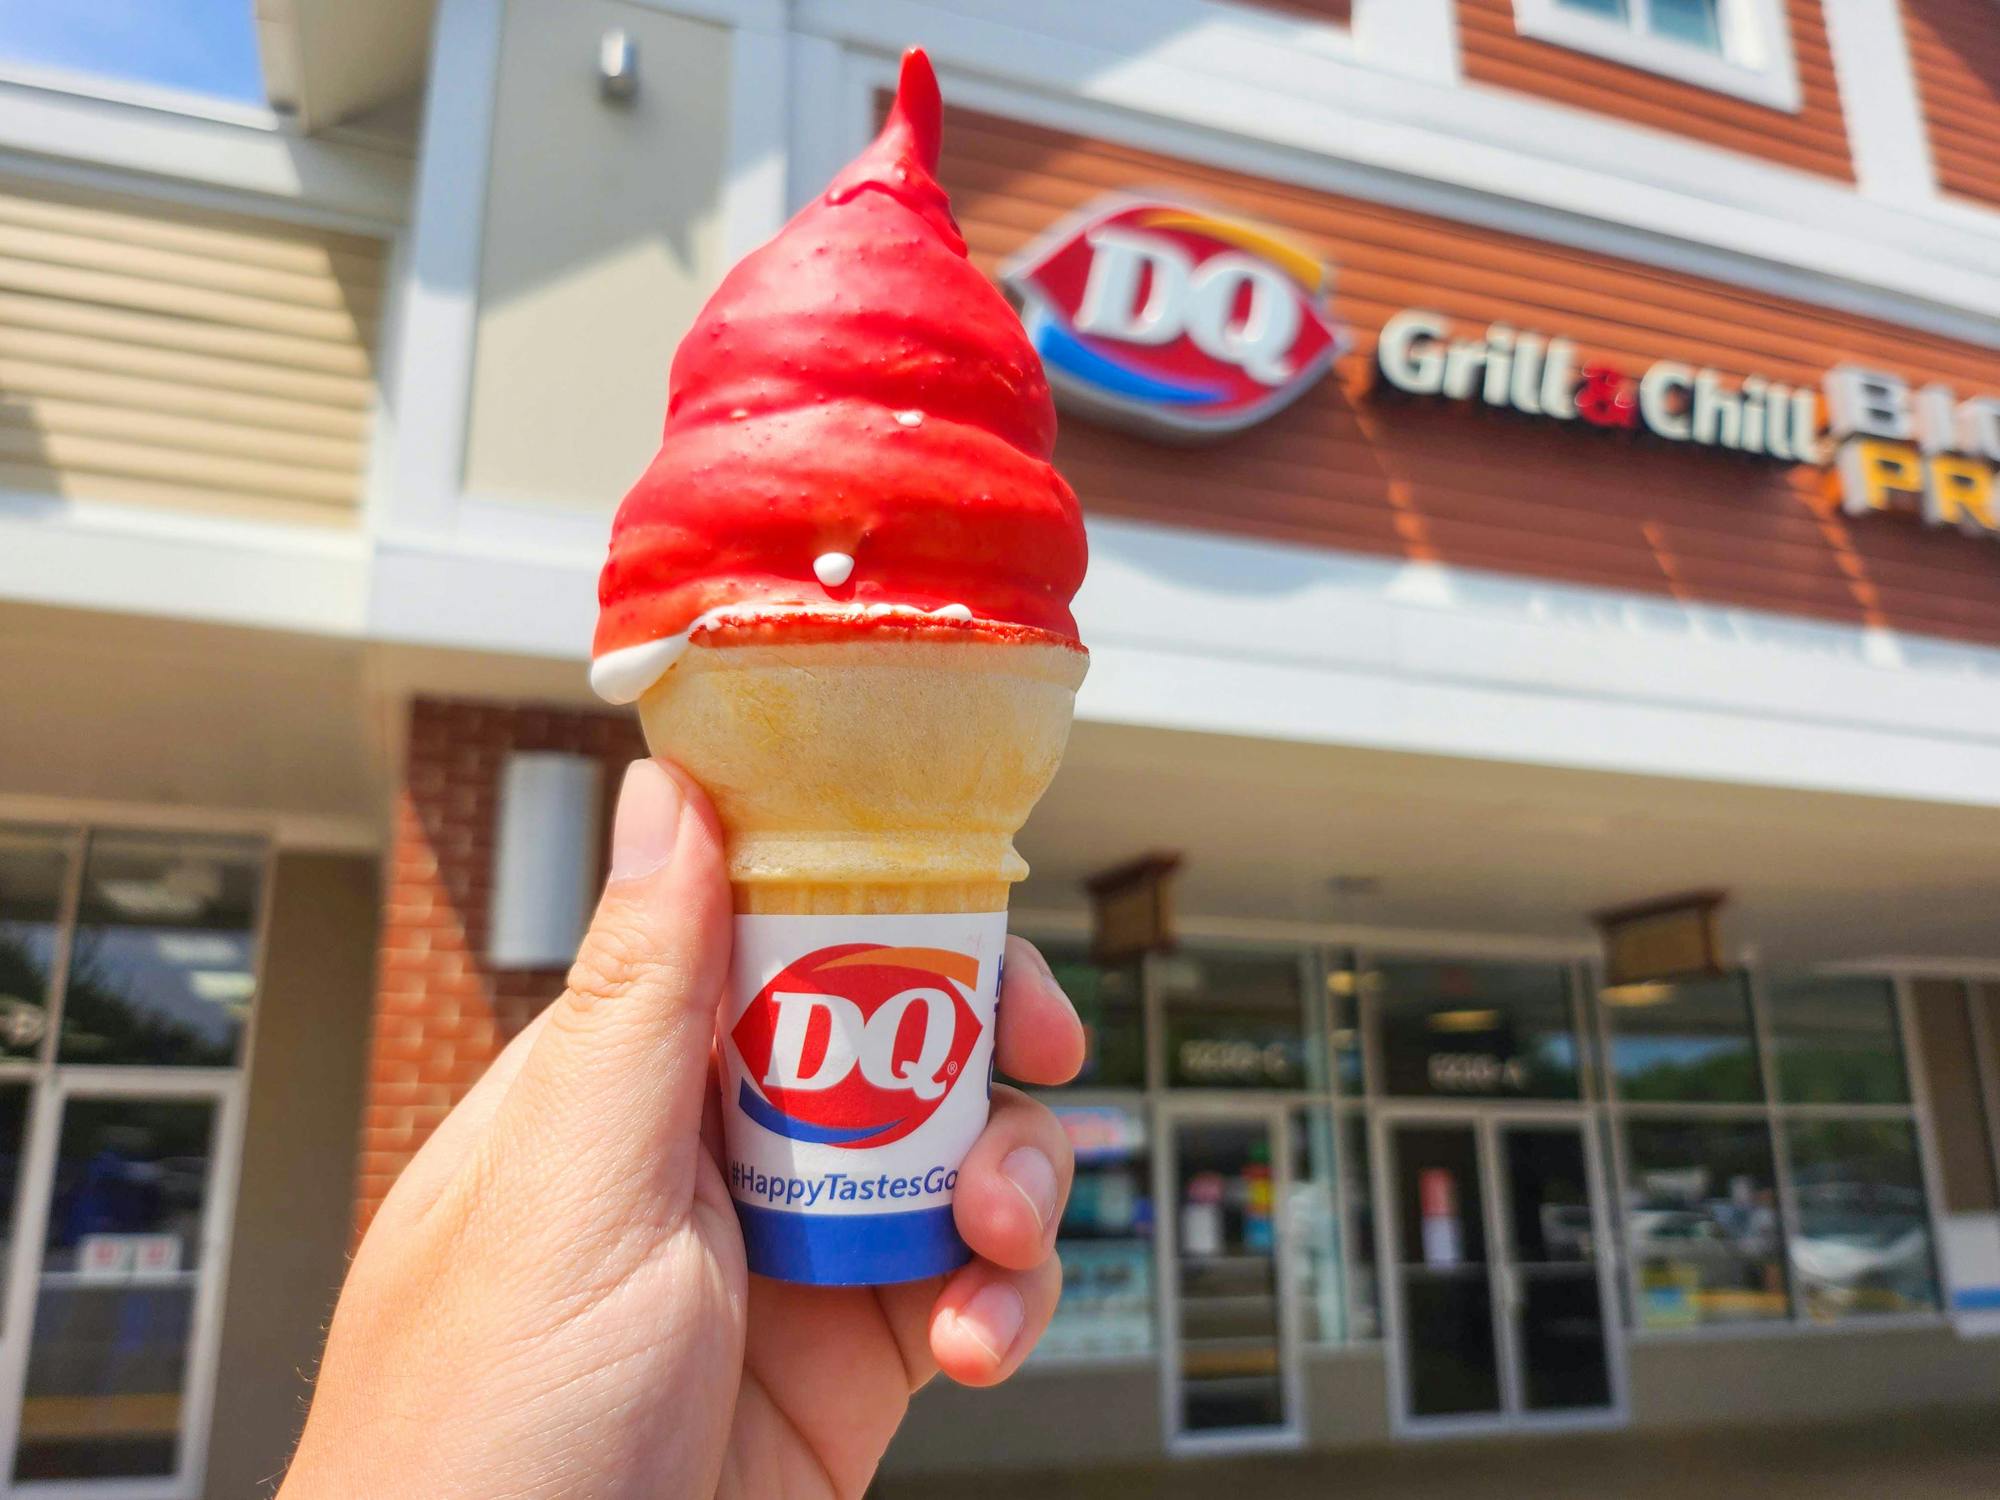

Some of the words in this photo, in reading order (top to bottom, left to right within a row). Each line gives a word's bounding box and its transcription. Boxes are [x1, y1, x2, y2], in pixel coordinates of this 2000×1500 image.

[1074, 228, 1298, 386] DQ
[1378, 309, 1580, 420] Grill
[1639, 360, 1827, 465] Chill
[1839, 438, 2000, 532] PR
[762, 987, 956, 1101] DQ
[732, 1160, 958, 1206] #HappyTastesGo
